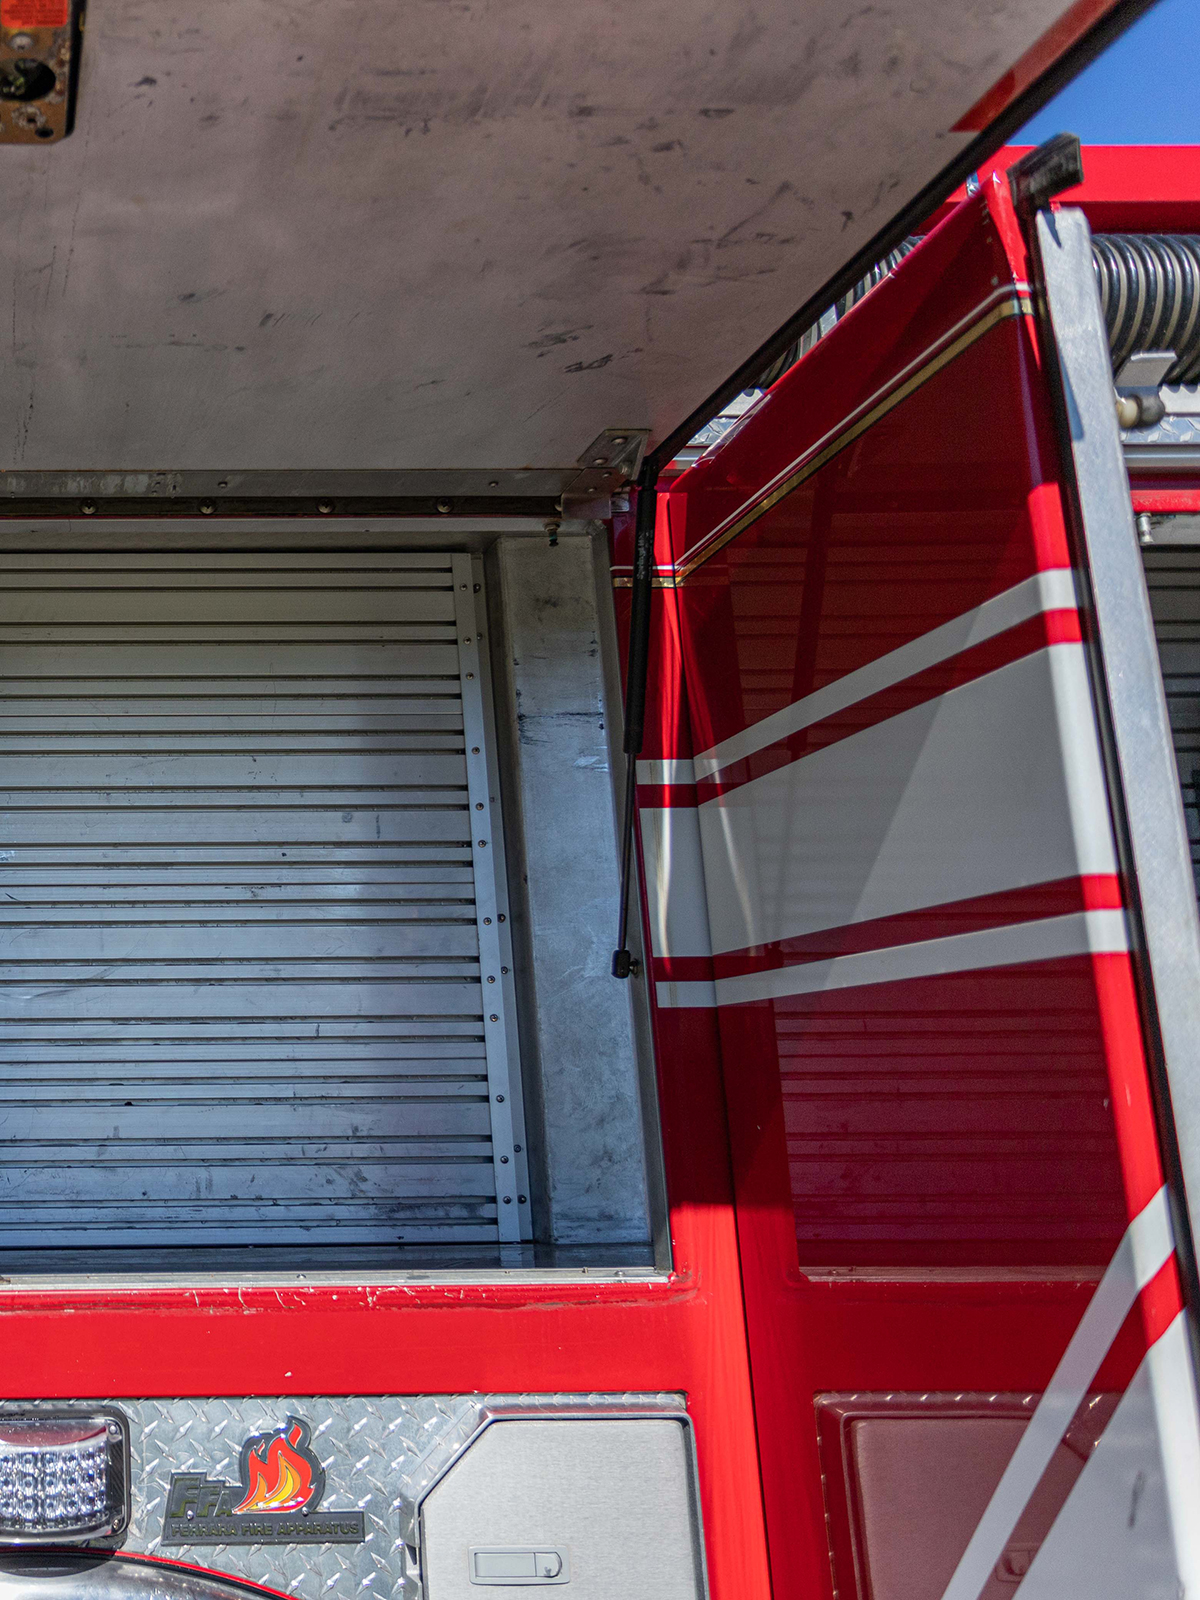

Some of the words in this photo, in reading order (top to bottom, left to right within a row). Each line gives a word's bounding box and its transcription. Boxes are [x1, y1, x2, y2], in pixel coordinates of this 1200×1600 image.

[171, 1523, 237, 1537] FERRARA
[242, 1523, 273, 1536] FIRE
[277, 1521, 360, 1535] APPARATUS
